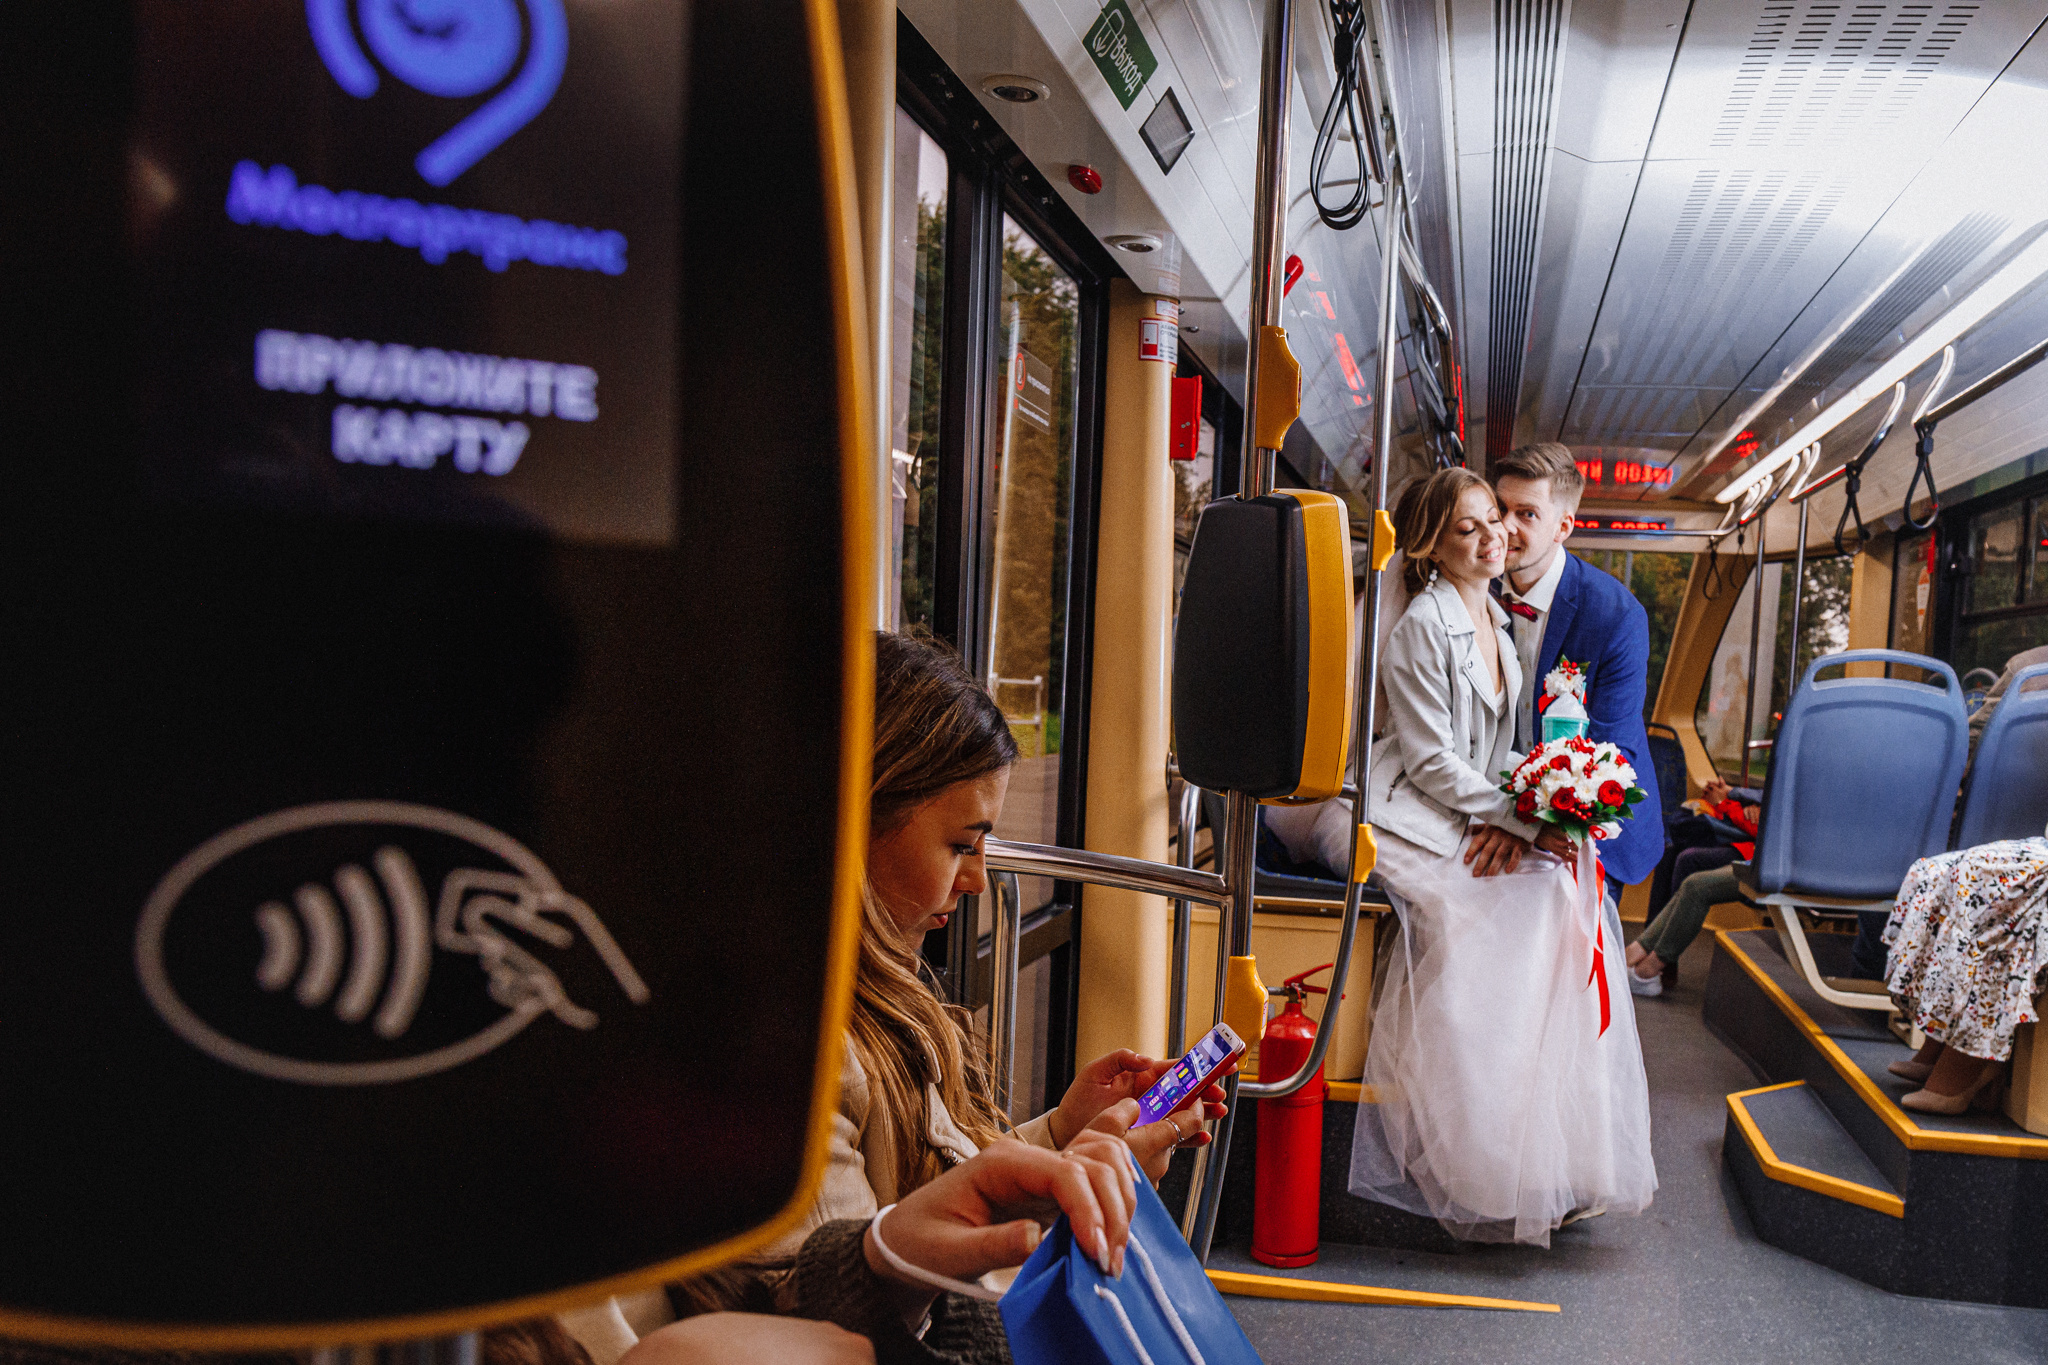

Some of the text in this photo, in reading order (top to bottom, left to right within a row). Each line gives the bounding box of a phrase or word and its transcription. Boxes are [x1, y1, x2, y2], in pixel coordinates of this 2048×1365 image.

[1109, 33, 1143, 97] Выход
[254, 328, 598, 422] ПРИЛОЖИТЕ
[331, 403, 531, 476] КАРТУ
